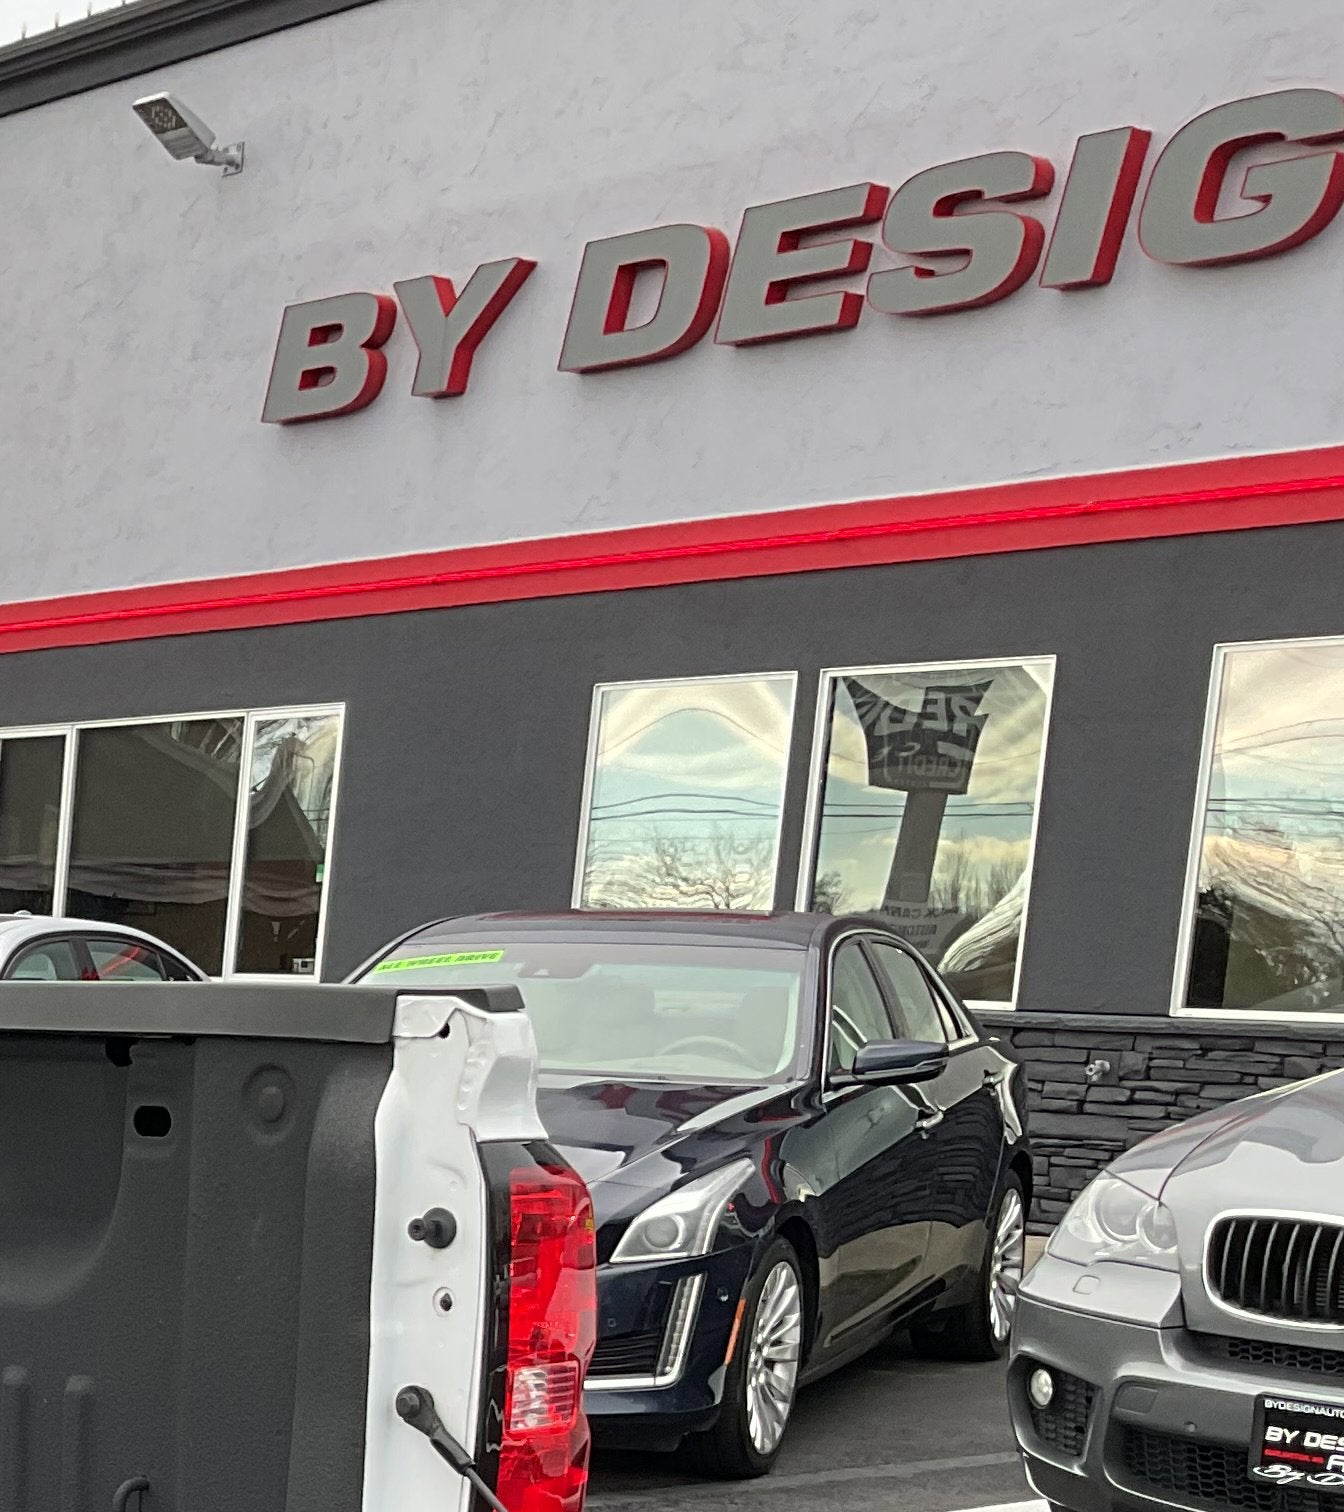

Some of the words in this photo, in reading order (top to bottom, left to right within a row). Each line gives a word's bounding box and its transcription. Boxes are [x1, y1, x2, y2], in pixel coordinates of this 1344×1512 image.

[262, 256, 538, 426] BY
[556, 86, 1344, 374] DESIG
[406, 955, 453, 967] WHEEL
[455, 952, 501, 962] DRIVE
[1265, 1425, 1300, 1444] BY
